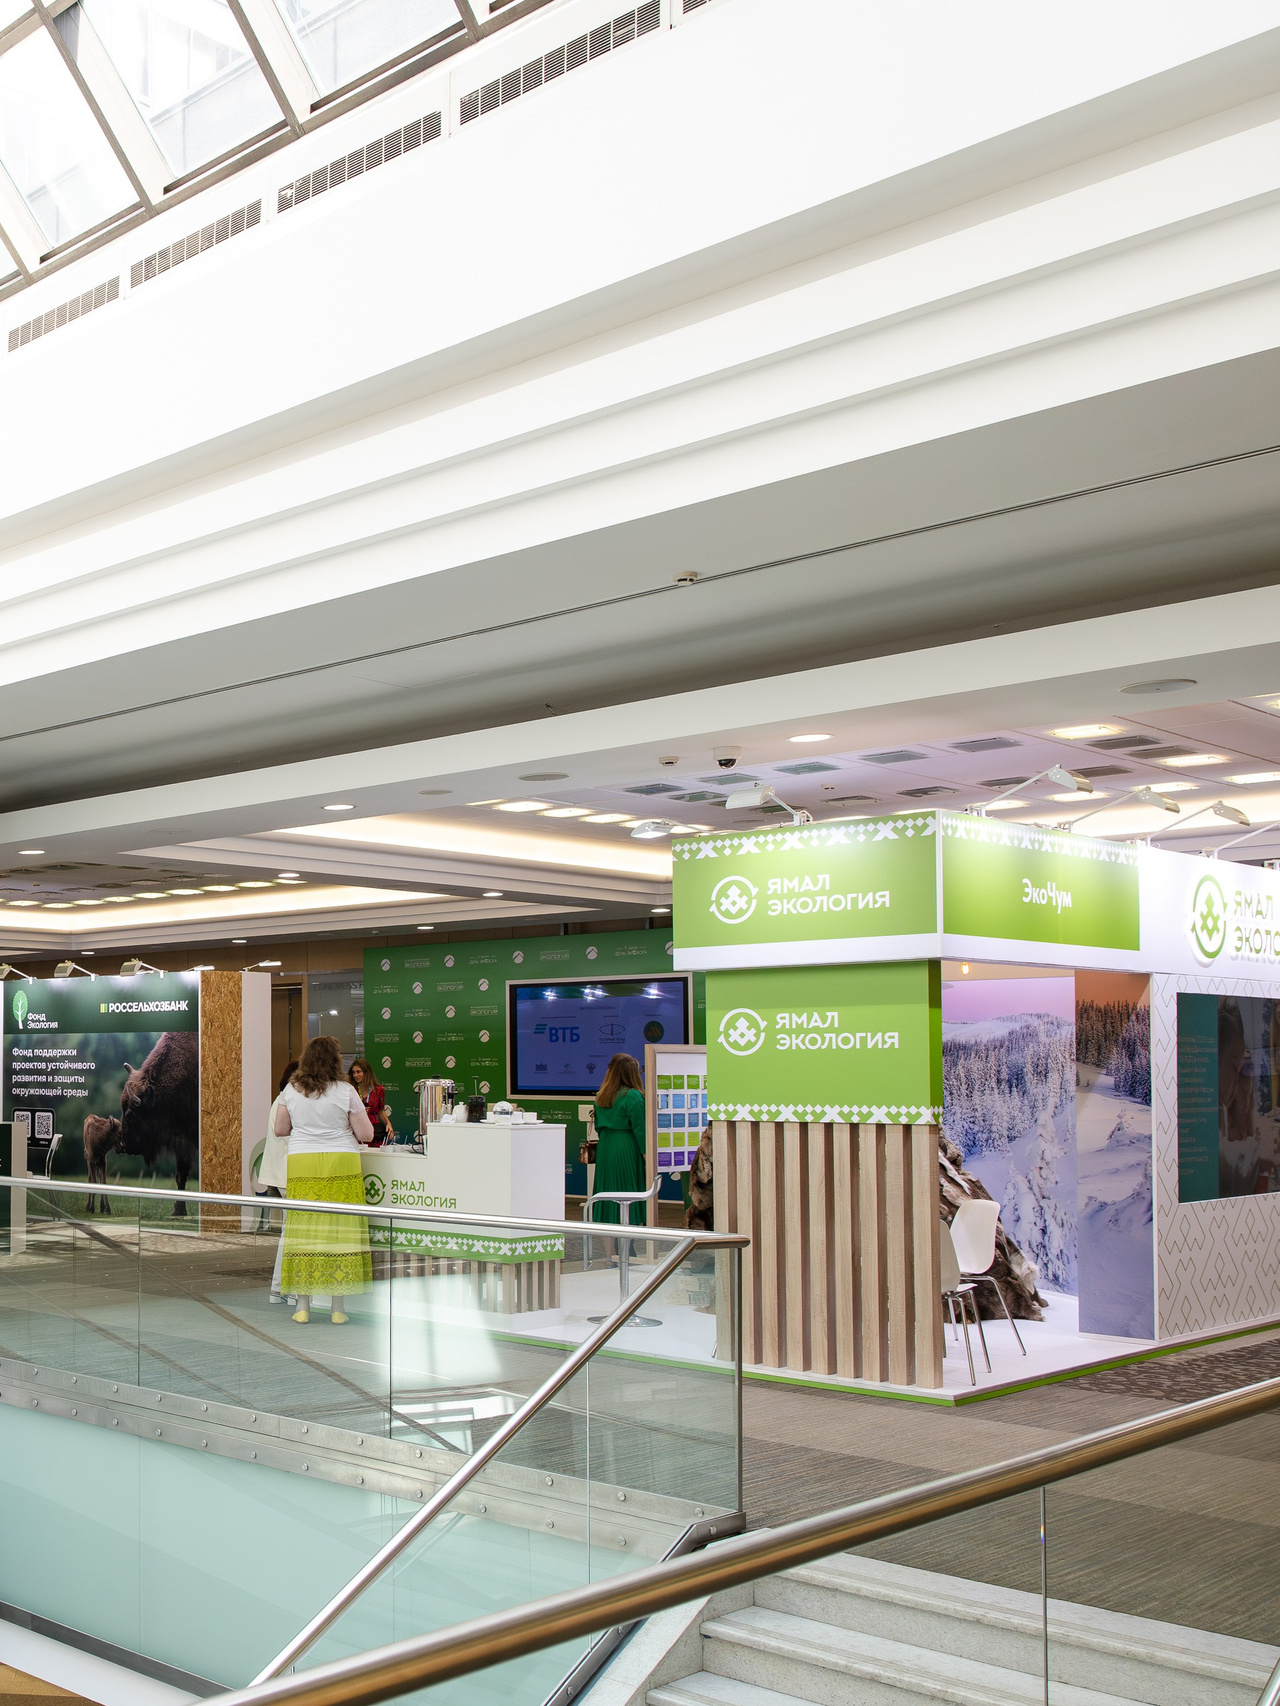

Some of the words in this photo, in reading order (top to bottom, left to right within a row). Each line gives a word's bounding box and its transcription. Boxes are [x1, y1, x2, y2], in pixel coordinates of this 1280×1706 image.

[767, 873, 830, 895] ЯМАЛ
[767, 890, 890, 916] ЭКОЛОГИЯ
[1021, 878, 1072, 914] ЭкоЧум
[1234, 890, 1273, 920] ЯМАЛ
[108, 1000, 189, 1013] РОССЕЛЬХОЗБАНК
[27, 1013, 46, 1021] Фонд
[775, 1011, 839, 1029] ЯМАЛ
[27, 1021, 59, 1029] Экология
[548, 1026, 581, 1043] ВТБ
[775, 1032, 899, 1051] ЭКОЛОГИЯ
[12, 1047, 33, 1058] Фонд
[34, 1049, 77, 1059] поддержки
[12, 1062, 46, 1071] проектов
[47, 1061, 96, 1071] устойчивого
[12, 1075, 46, 1084] развития
[54, 1075, 85, 1084] защиты
[12, 1086, 62, 1097] окружающей
[62, 1088, 89, 1098] среды
[391, 1179, 425, 1193] ЯМАЛ
[391, 1193, 457, 1209] ЭКОЛОГИЯ
